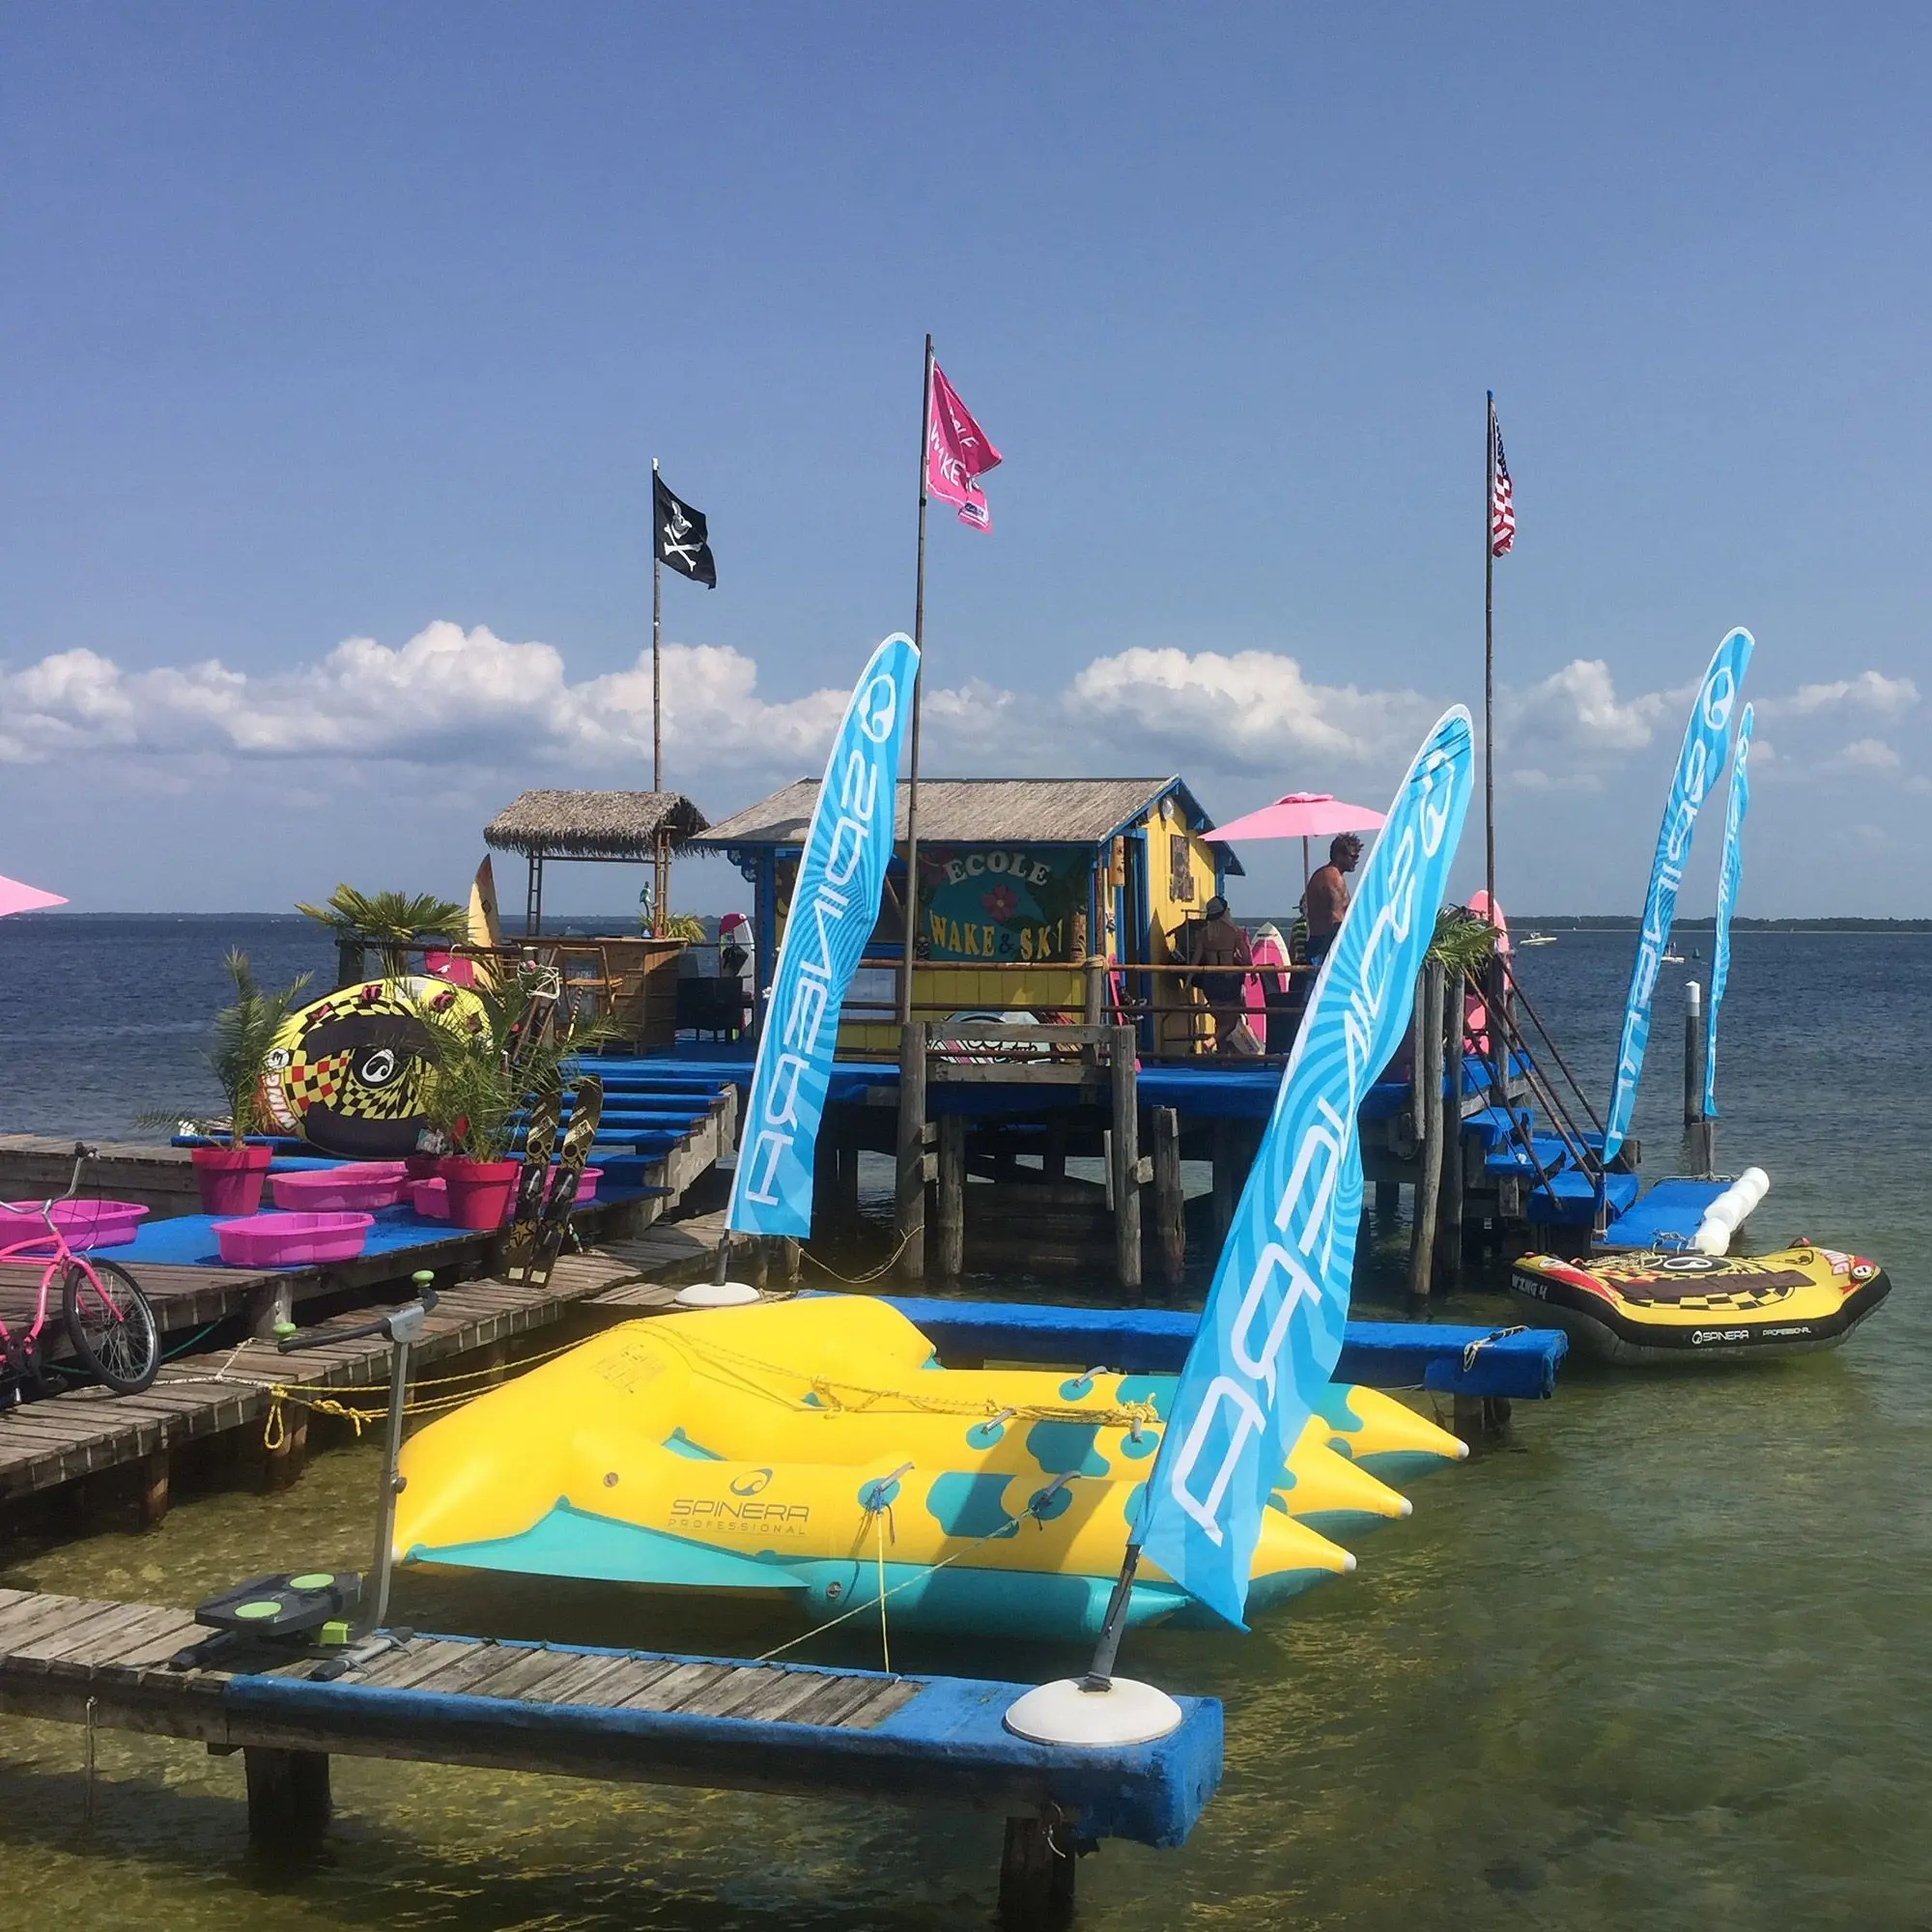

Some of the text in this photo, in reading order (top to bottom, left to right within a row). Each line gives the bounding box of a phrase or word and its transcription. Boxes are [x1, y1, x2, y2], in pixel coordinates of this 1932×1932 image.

[943, 850, 1051, 886] ECOLE
[928, 909, 995, 957] WAKE
[1019, 918, 1063, 960] SKI
[1511, 1273, 1538, 1296] WING
[1702, 1326, 1812, 1342] SPINERA PROFESSIONAL
[670, 1499, 810, 1522] SPINERA
[667, 1518, 806, 1535] PROFESSIONAL
